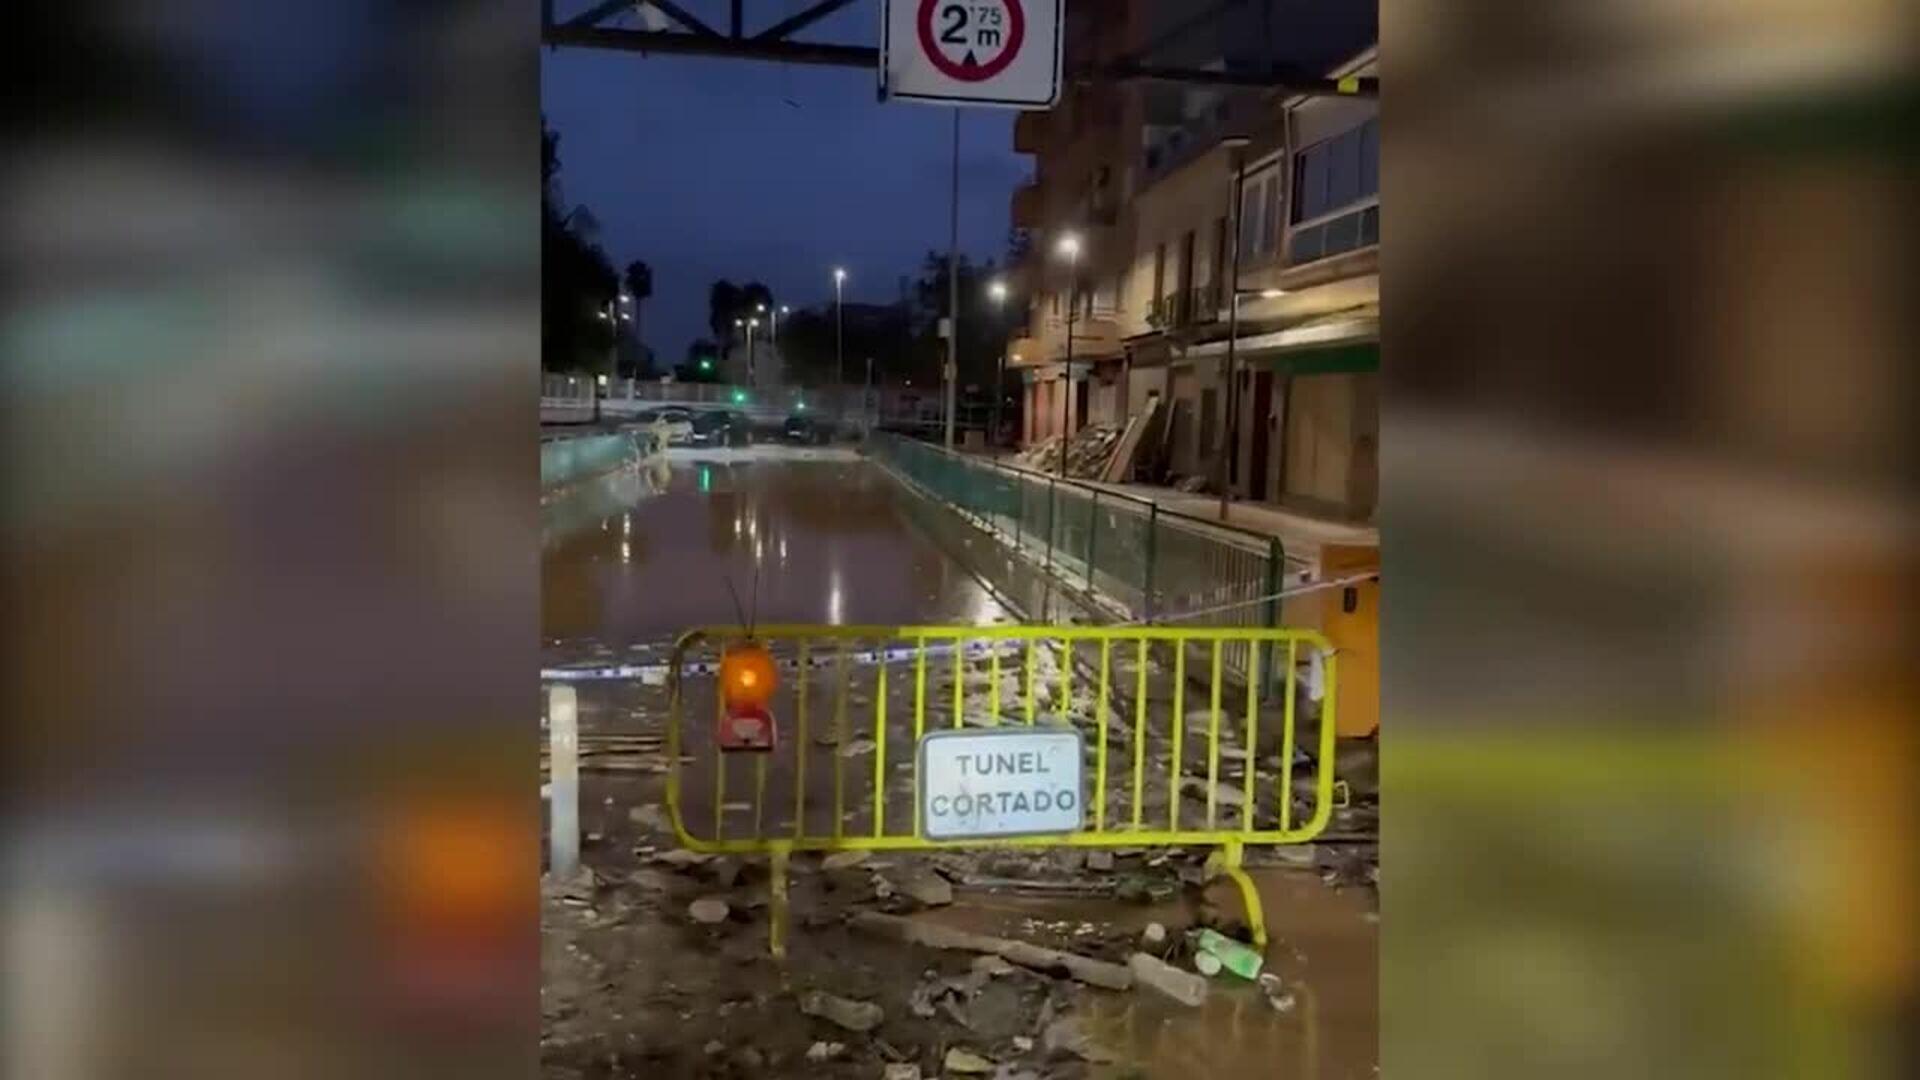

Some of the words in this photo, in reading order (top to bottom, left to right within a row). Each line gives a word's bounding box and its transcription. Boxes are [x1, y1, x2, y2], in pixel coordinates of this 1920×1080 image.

[940, 4, 968, 44] 2
[977, 28, 1000, 46] m
[956, 752, 1050, 776] TUNEL
[930, 789, 1076, 817] CORTADO
